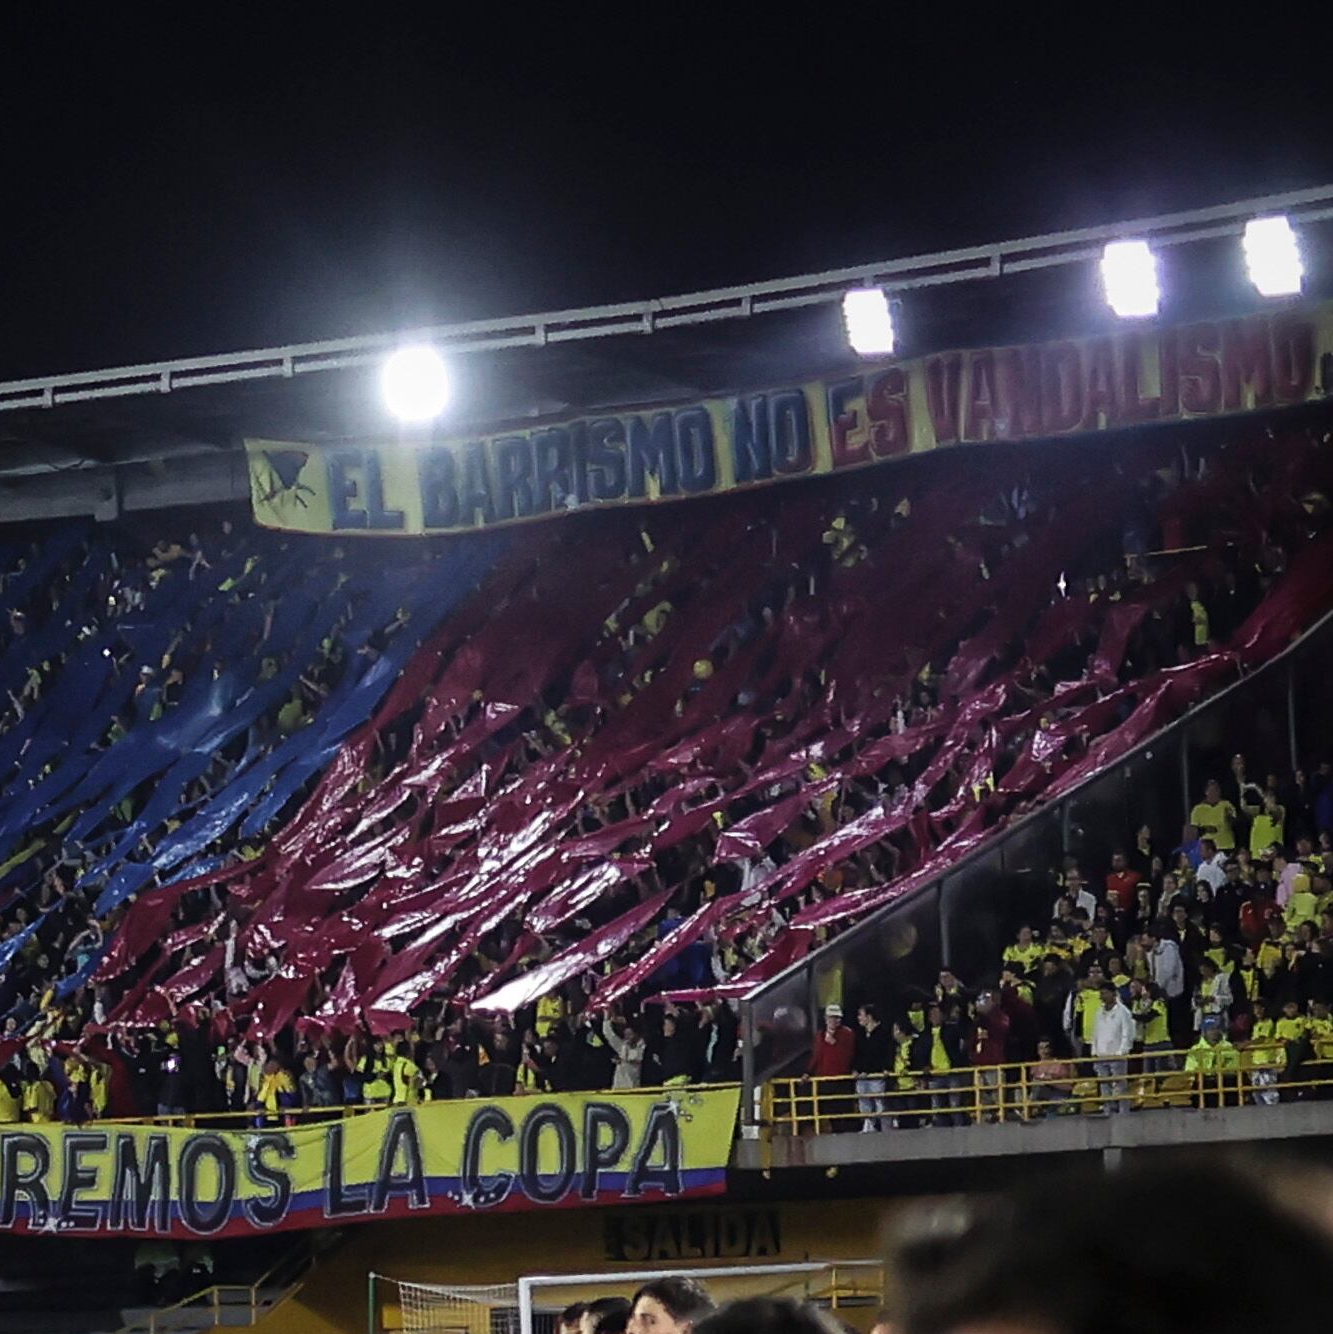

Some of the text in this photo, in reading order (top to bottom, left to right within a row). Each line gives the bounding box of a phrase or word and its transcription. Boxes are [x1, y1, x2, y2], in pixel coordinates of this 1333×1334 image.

[330, 309, 1315, 532] EL BARRISMO NO ES VANDALISMO
[323, 1106, 432, 1220] LA
[454, 1098, 690, 1208] COPA
[621, 1209, 781, 1259] SALIDA
